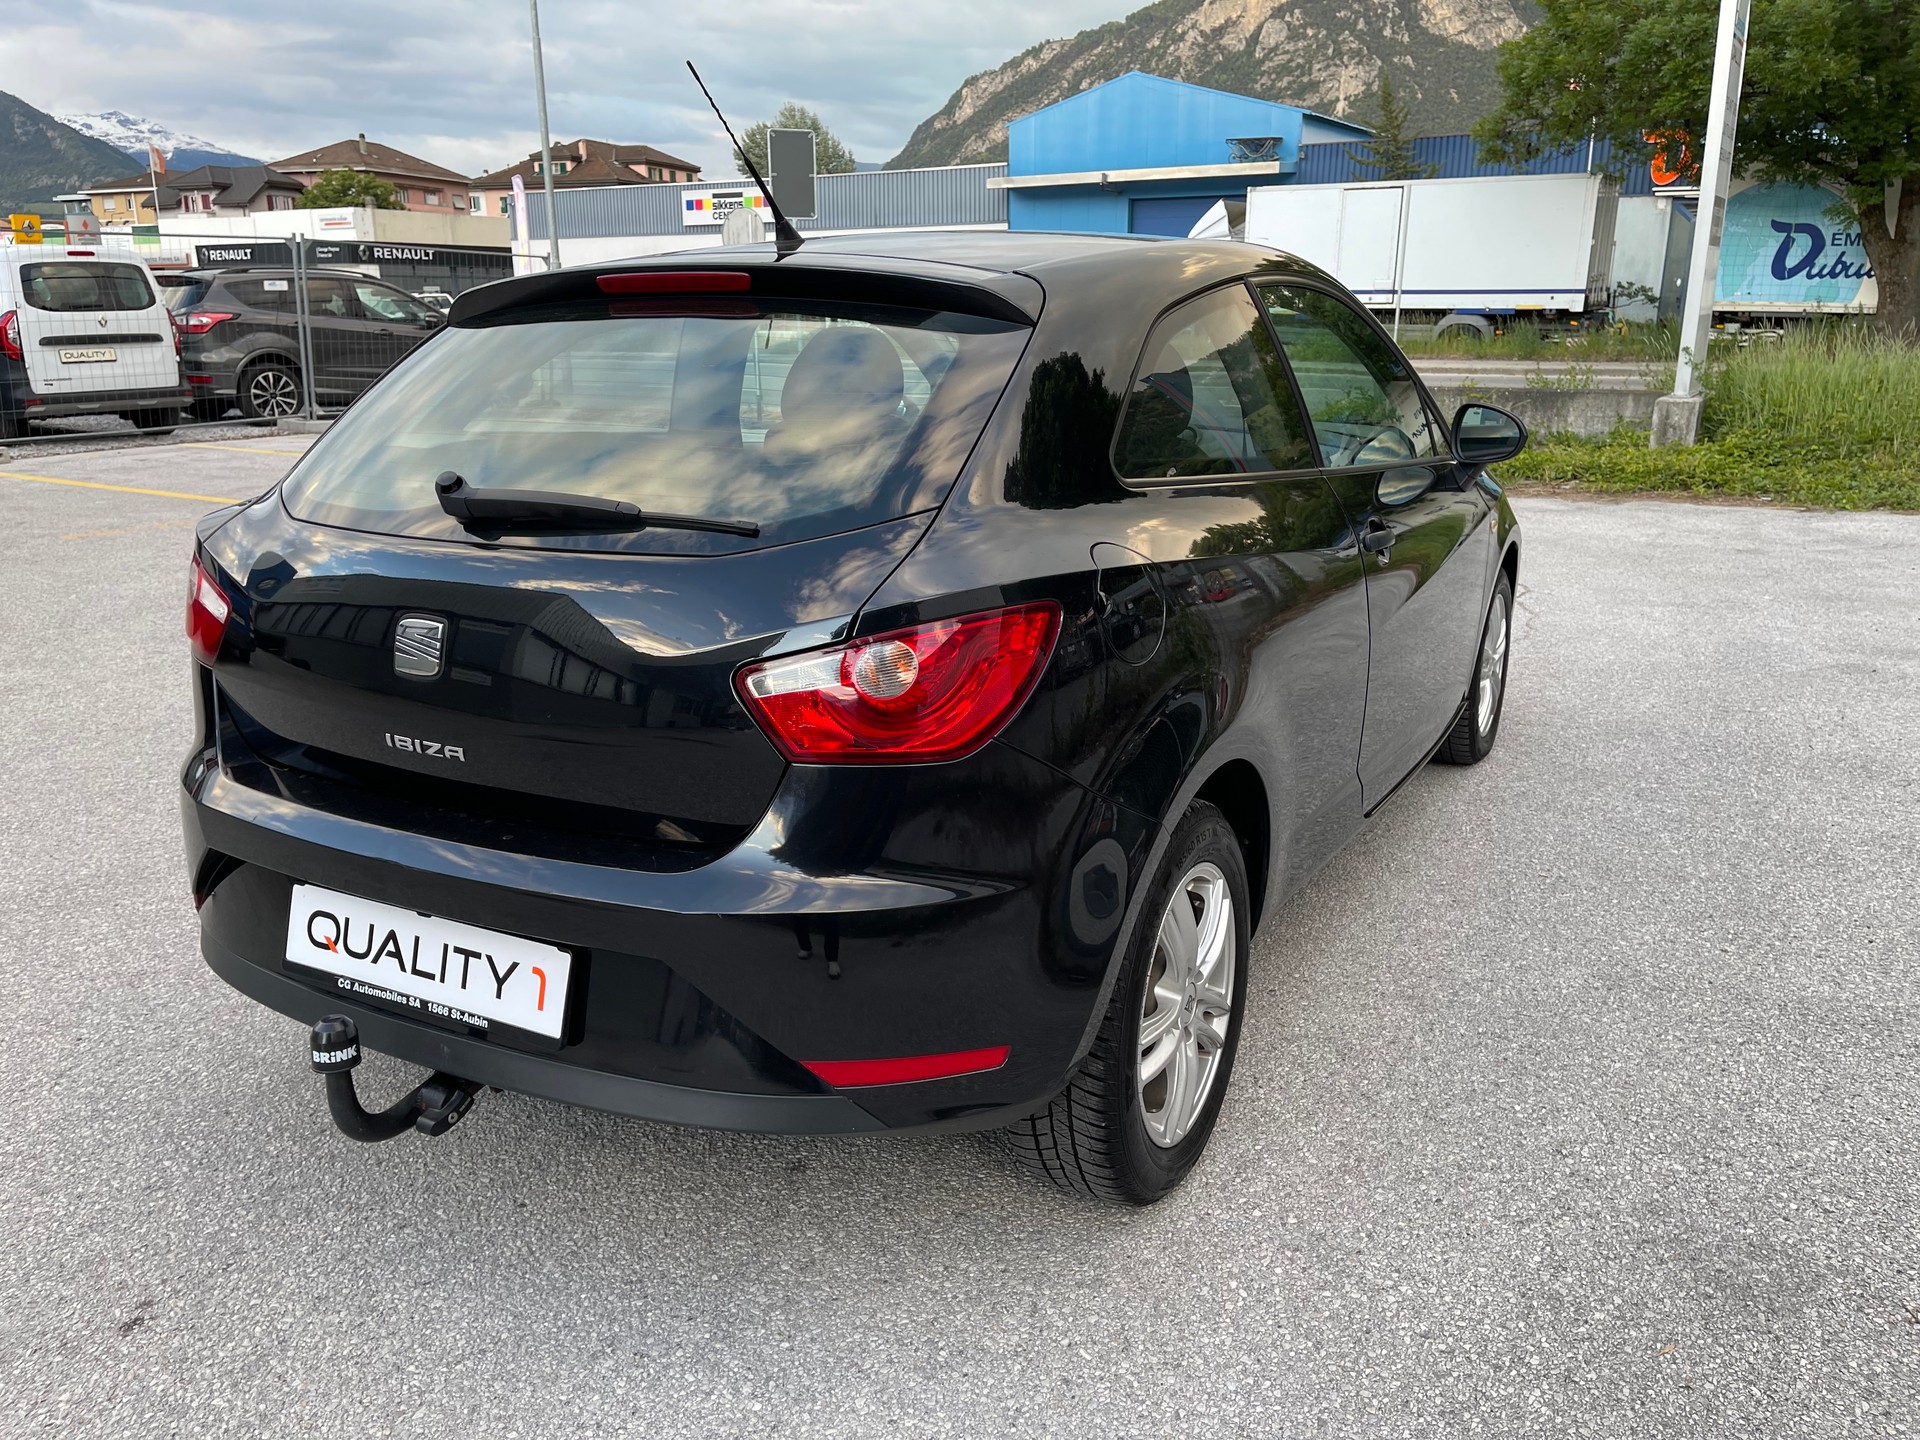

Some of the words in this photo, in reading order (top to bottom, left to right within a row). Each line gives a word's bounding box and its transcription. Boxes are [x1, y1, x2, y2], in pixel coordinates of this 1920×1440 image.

[712, 200, 744, 210] sikkens
[712, 211, 731, 220] CEN
[1831, 229, 1864, 247] ÉM
[209, 248, 252, 261] RENAULT
[373, 247, 435, 260] RENAULT
[385, 732, 466, 762] IBIZA
[307, 910, 520, 1000] QUALITY
[531, 966, 547, 1012] 1
[337, 978, 351, 990] CG
[353, 982, 408, 1005] Automobiles
[408, 996, 421, 1009] SA
[427, 1002, 449, 1016] 1566
[450, 1008, 489, 1029] St-Aubin
